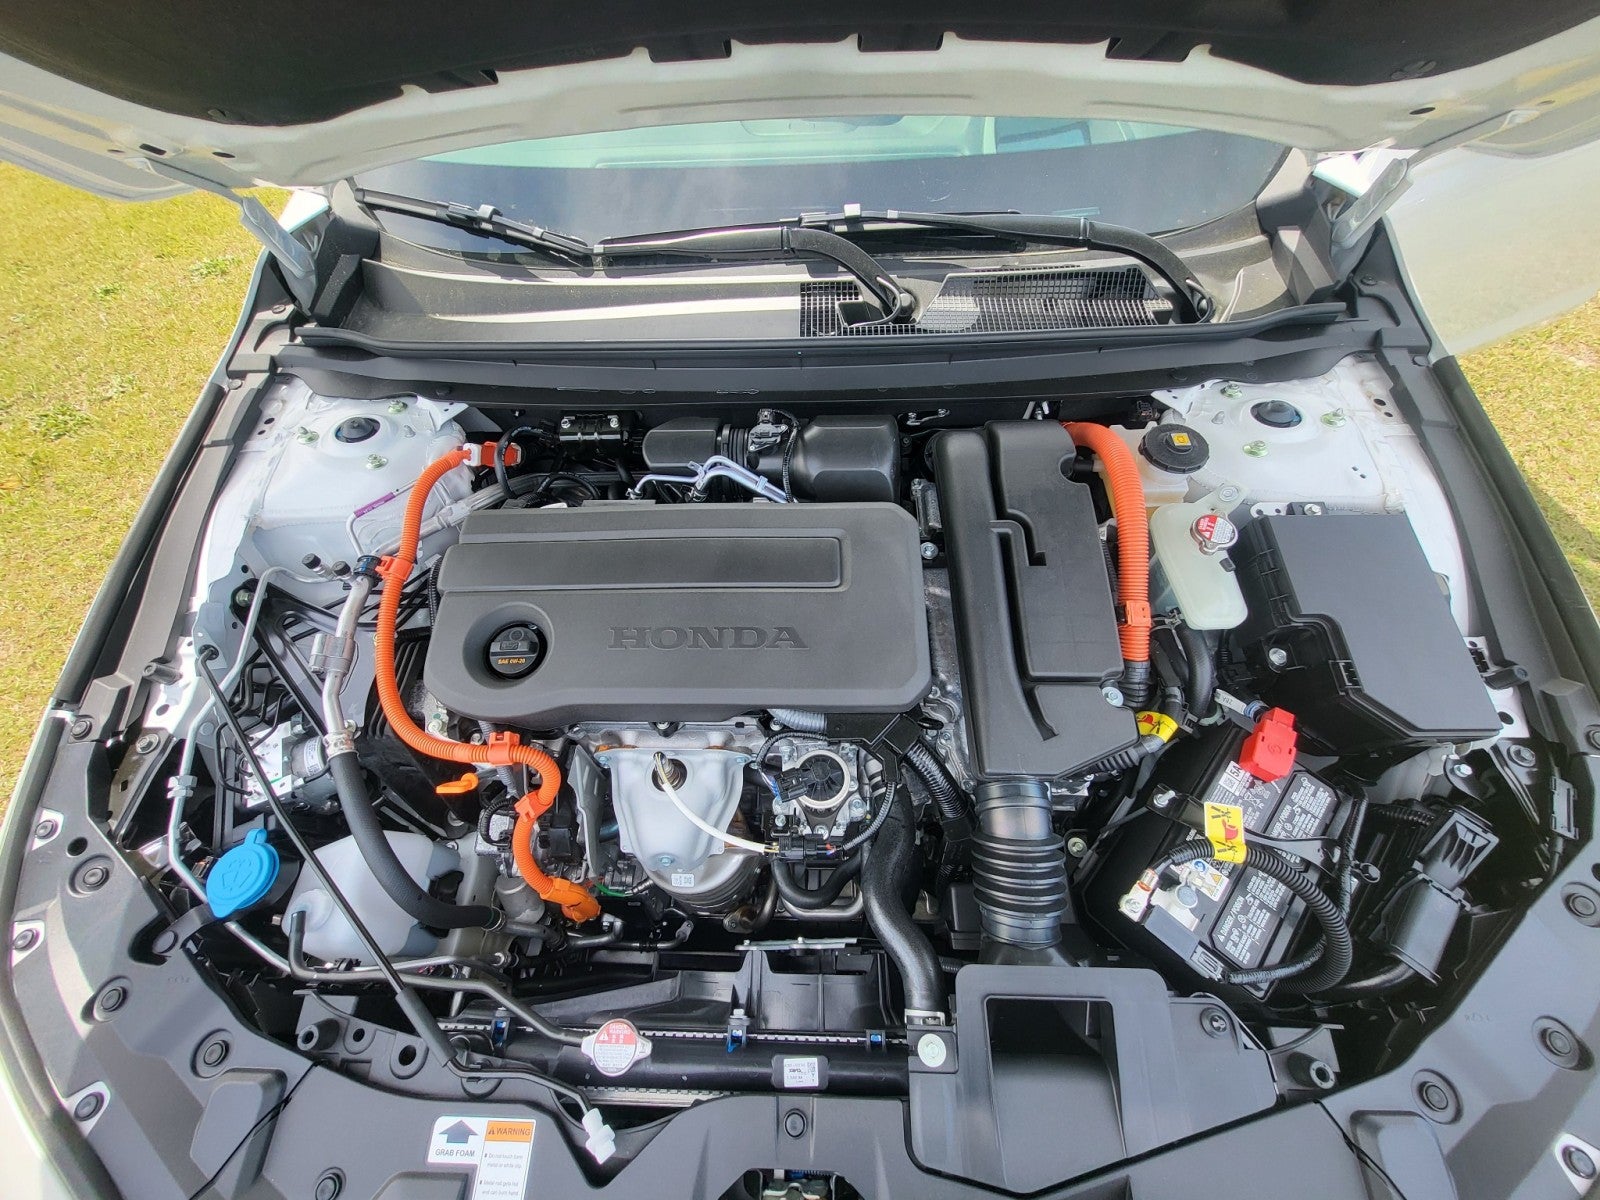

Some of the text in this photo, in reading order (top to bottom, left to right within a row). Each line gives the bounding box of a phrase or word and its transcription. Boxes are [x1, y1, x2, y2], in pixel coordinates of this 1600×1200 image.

[607, 625, 810, 651] HONDA
[496, 1127, 531, 1136] WARNING
[434, 1148, 476, 1157] GRAB FOAM
